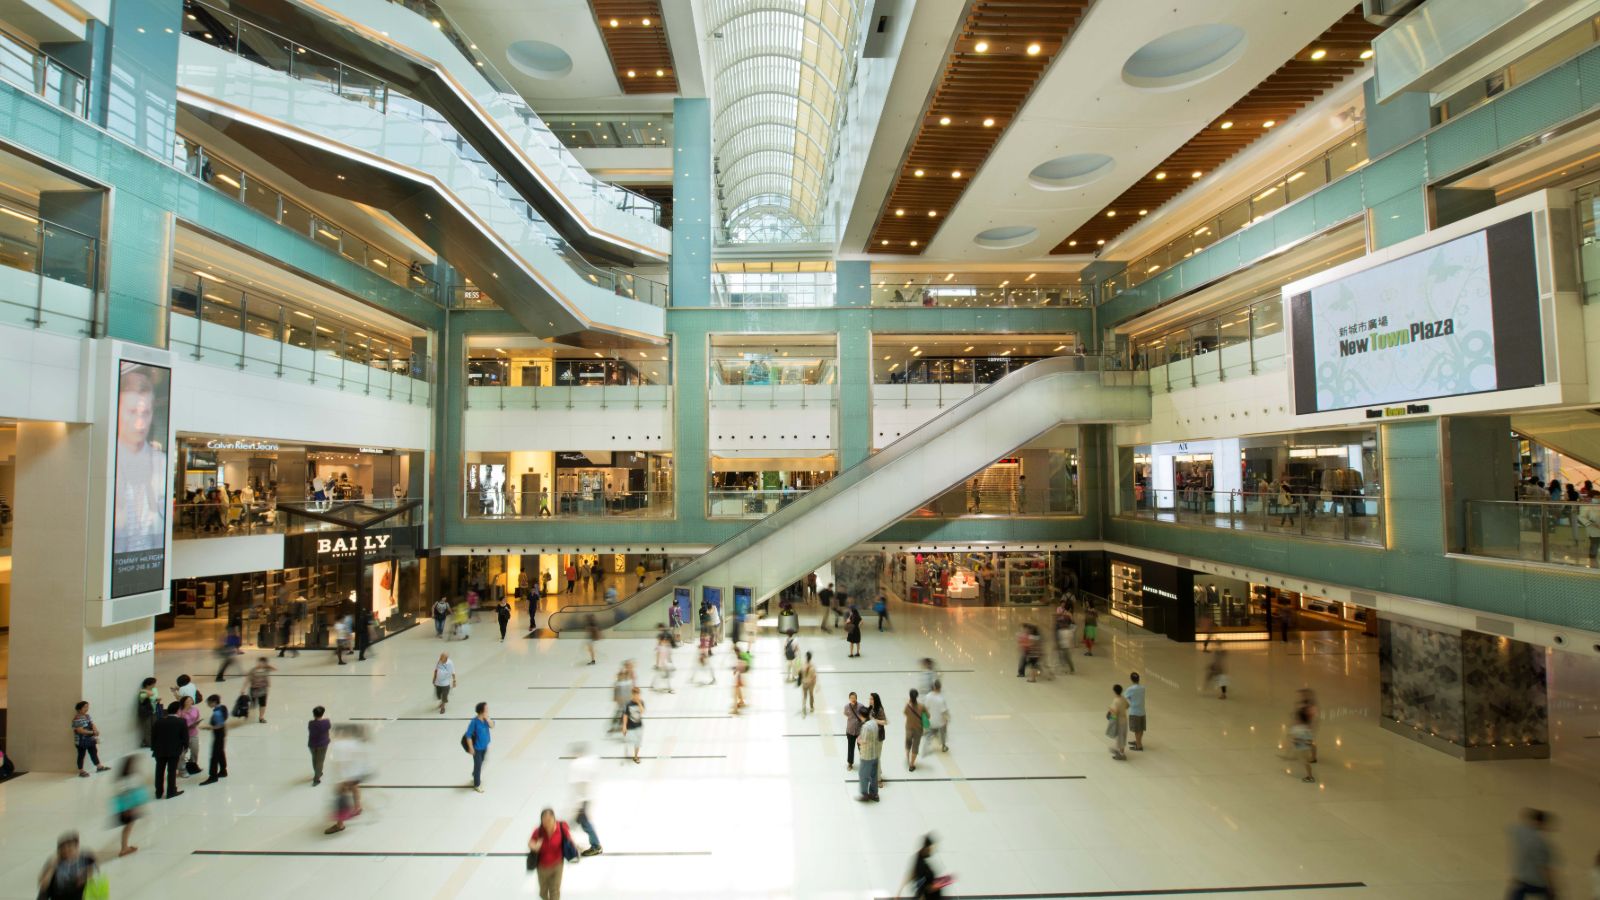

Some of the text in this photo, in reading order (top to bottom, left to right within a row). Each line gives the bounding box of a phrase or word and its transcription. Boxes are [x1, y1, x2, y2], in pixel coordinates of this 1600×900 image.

[1338, 315, 1388, 337] 新城市廣場
[1340, 318, 1454, 357] New Town Plaza
[1384, 407, 1406, 417] Town
[207, 440, 279, 451] Calvin Klein Jeans
[114, 557, 139, 567] TOMMY
[118, 564, 135, 573] SHOP
[88, 641, 153, 668] New Town Plaza
